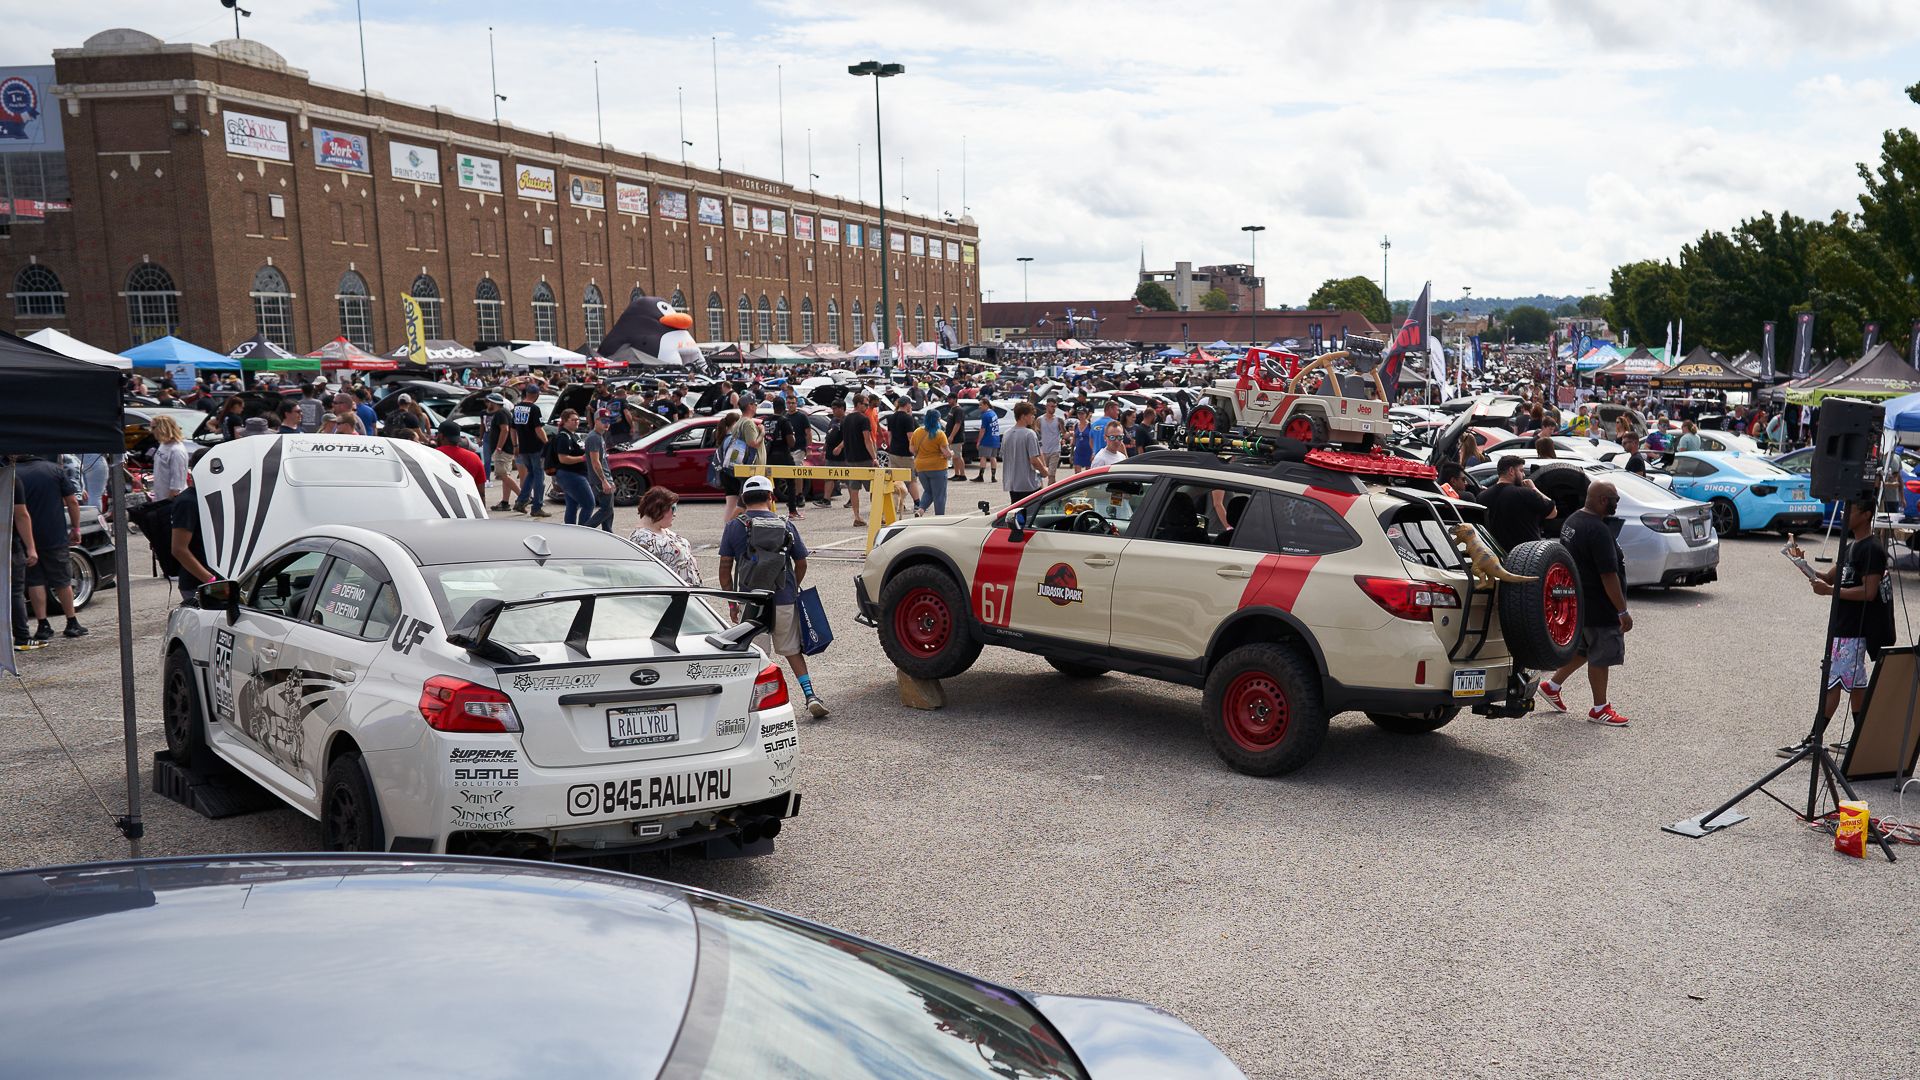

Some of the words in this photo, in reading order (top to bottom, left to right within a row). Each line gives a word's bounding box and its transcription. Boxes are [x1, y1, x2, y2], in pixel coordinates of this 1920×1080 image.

[245, 118, 277, 140] YORK
[329, 141, 353, 158] York
[394, 167, 437, 181] PRINT-O-STAT
[740, 179, 760, 190] YORK
[764, 184, 780, 194] FAIR
[882, 358, 890, 366] 15
[1357, 403, 1372, 415] Jeep
[311, 444, 369, 452] YELLOW
[792, 468, 813, 477] YORK
[828, 469, 850, 477] FAIR
[1704, 484, 1737, 493] DINOCO
[340, 584, 366, 601] DEFINO
[1037, 583, 1065, 599] JURASSIC
[1064, 587, 1083, 601] PARK
[334, 602, 360, 619] DEFINO
[981, 582, 1009, 625] 67
[996, 628, 1024, 638] OUTBACK
[701, 662, 752, 677] YELLOW
[532, 673, 601, 689] YELLOW
[618, 714, 669, 737] RALLYRU
[761, 720, 794, 735] SUPREME
[625, 736, 666, 745] EAGLES
[449, 749, 518, 759] SUPREME
[454, 768, 519, 780] SUBTLE
[450, 818, 516, 830] AUTOMOTIVE
